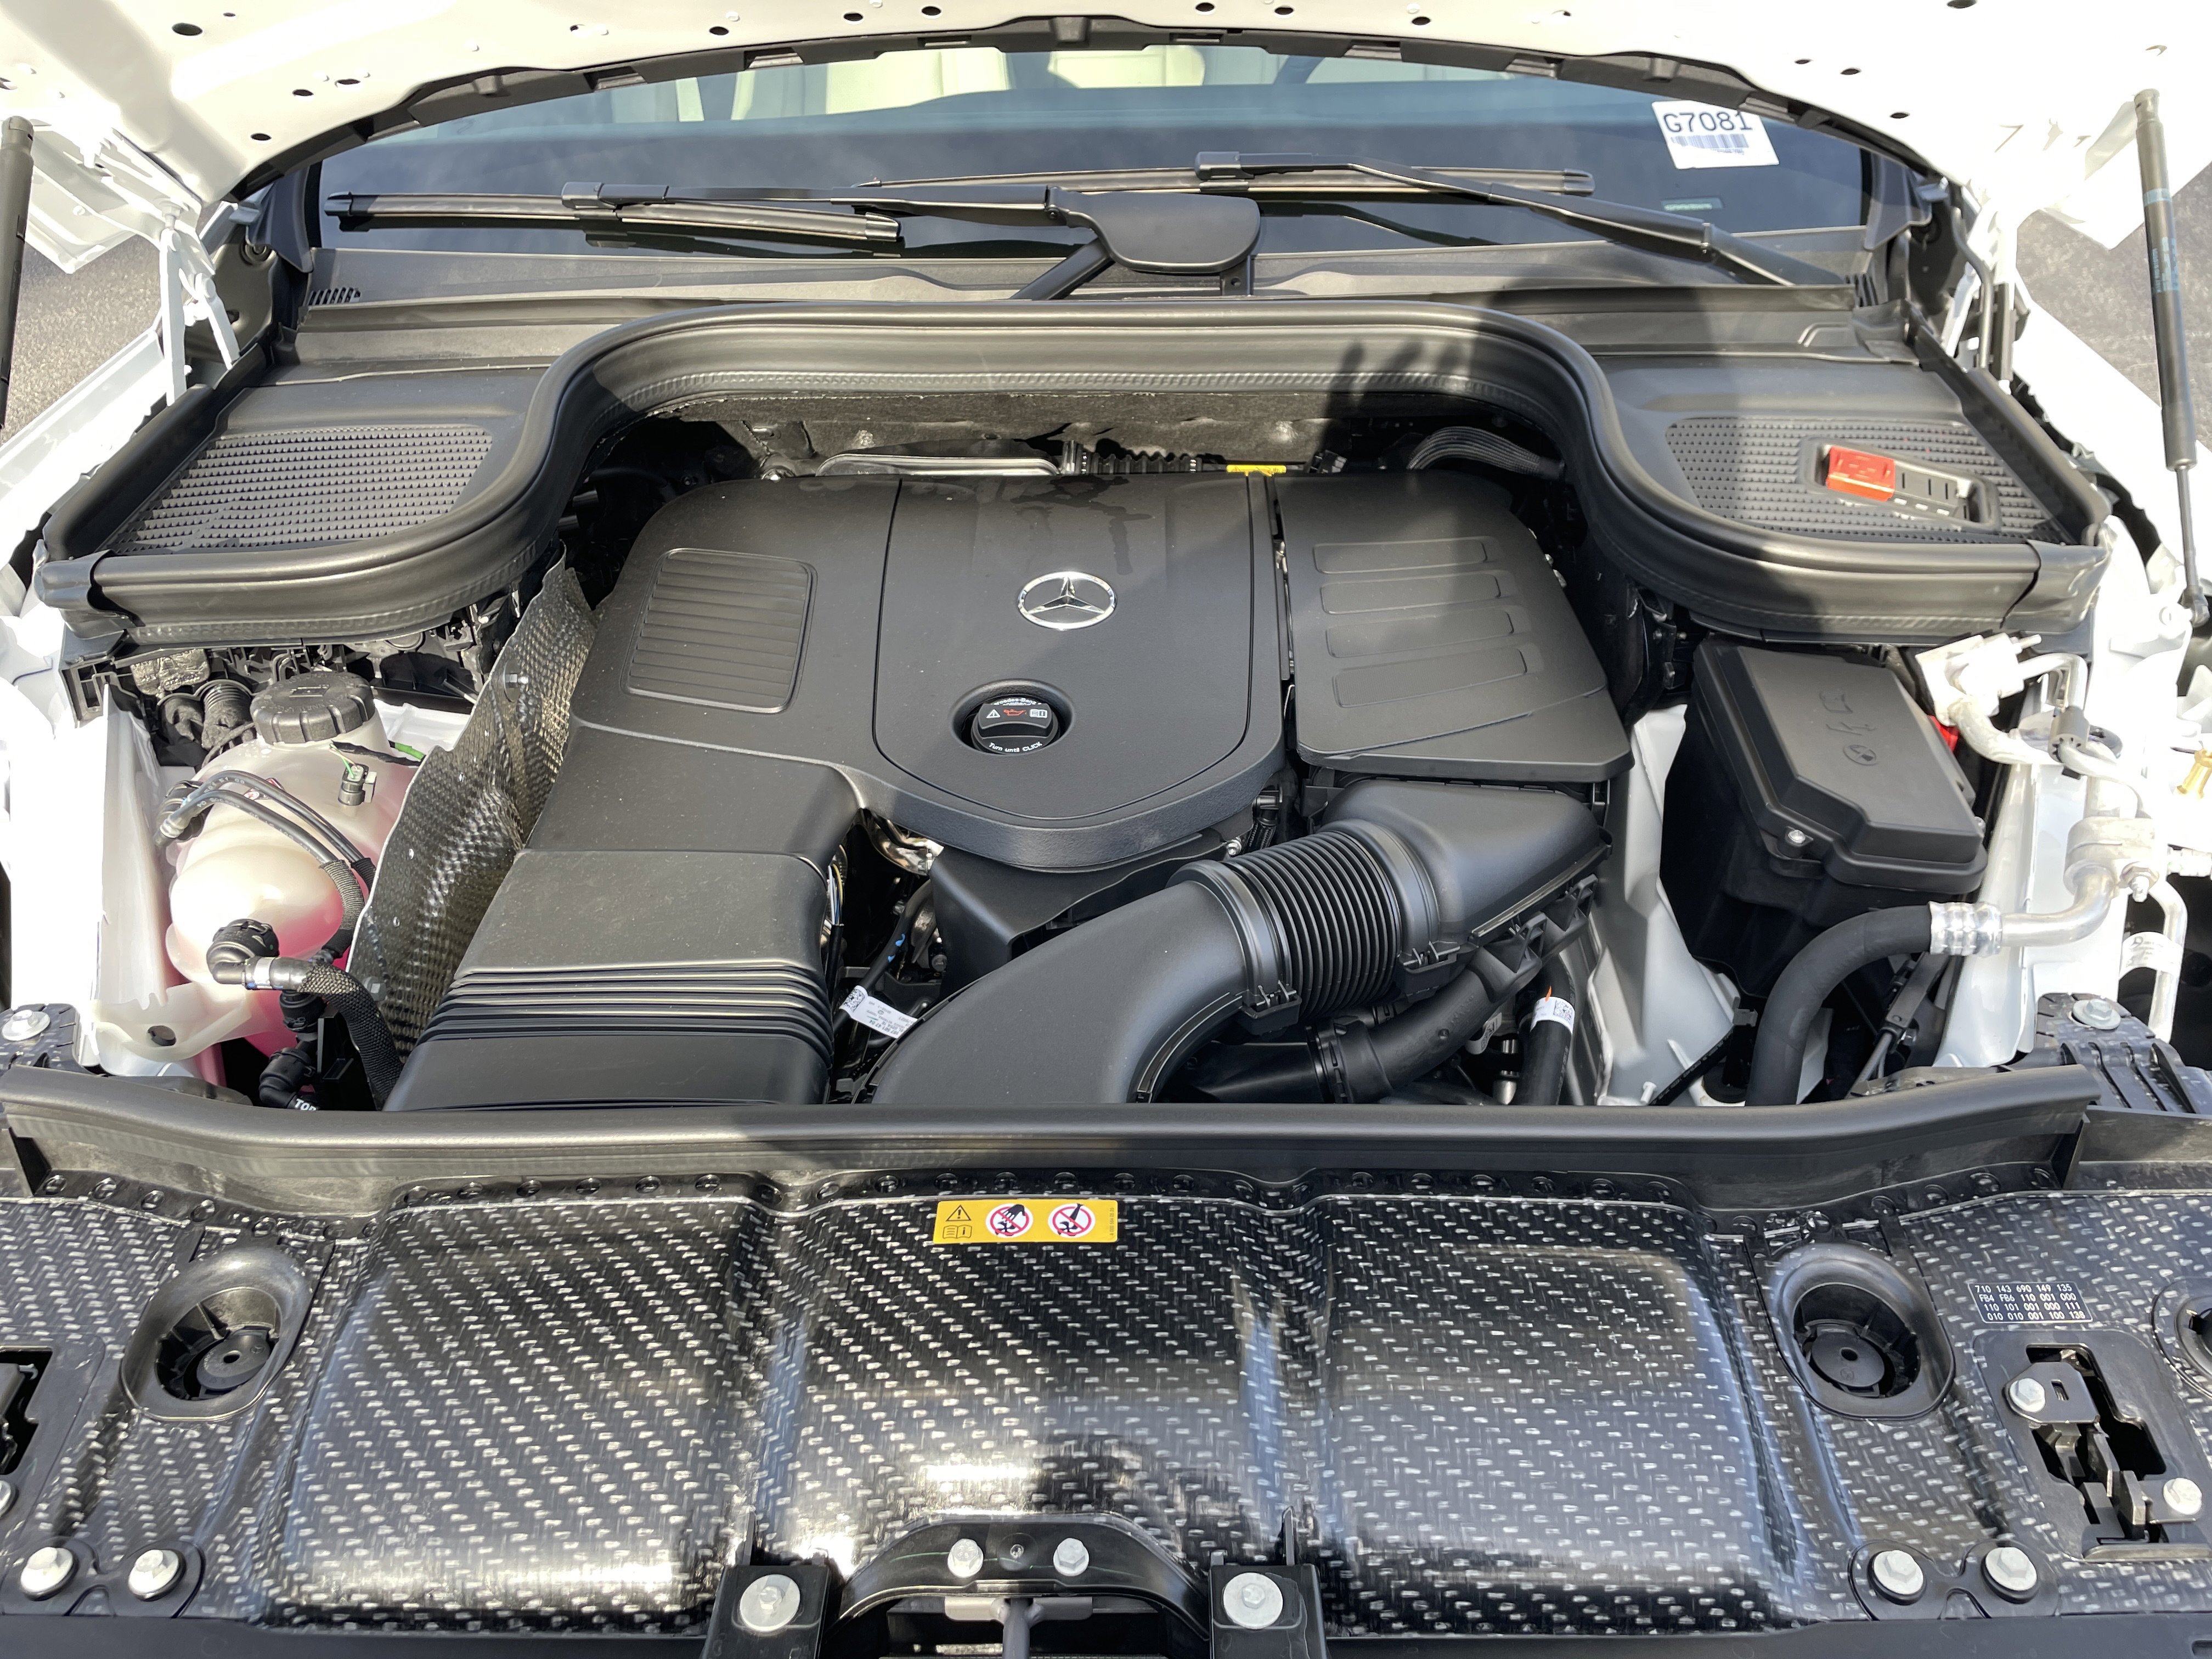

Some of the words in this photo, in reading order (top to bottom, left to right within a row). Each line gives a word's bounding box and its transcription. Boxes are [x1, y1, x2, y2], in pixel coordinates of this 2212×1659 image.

[1663, 110, 1753, 132] G7081
[989, 742, 1003, 751] Turn
[1022, 741, 1042, 752] CLICK
[2016, 1284, 2032, 1293] 690
[1979, 1294, 1994, 1302] FB4
[1999, 1294, 2015, 1302] FB6
[2021, 1293, 2036, 1301] 110
[2040, 1293, 2056, 1301] 001
[2060, 1293, 2076, 1301] 000
[2023, 1302, 2040, 1311] 001
[2044, 1302, 2061, 1311] 000
[1987, 1312, 2004, 1321] 010
[2007, 1312, 2024, 1321] 010
[2028, 1311, 2044, 1320] 001
[2049, 1311, 2065, 1319] 100
[2069, 1311, 2086, 1319] 138
